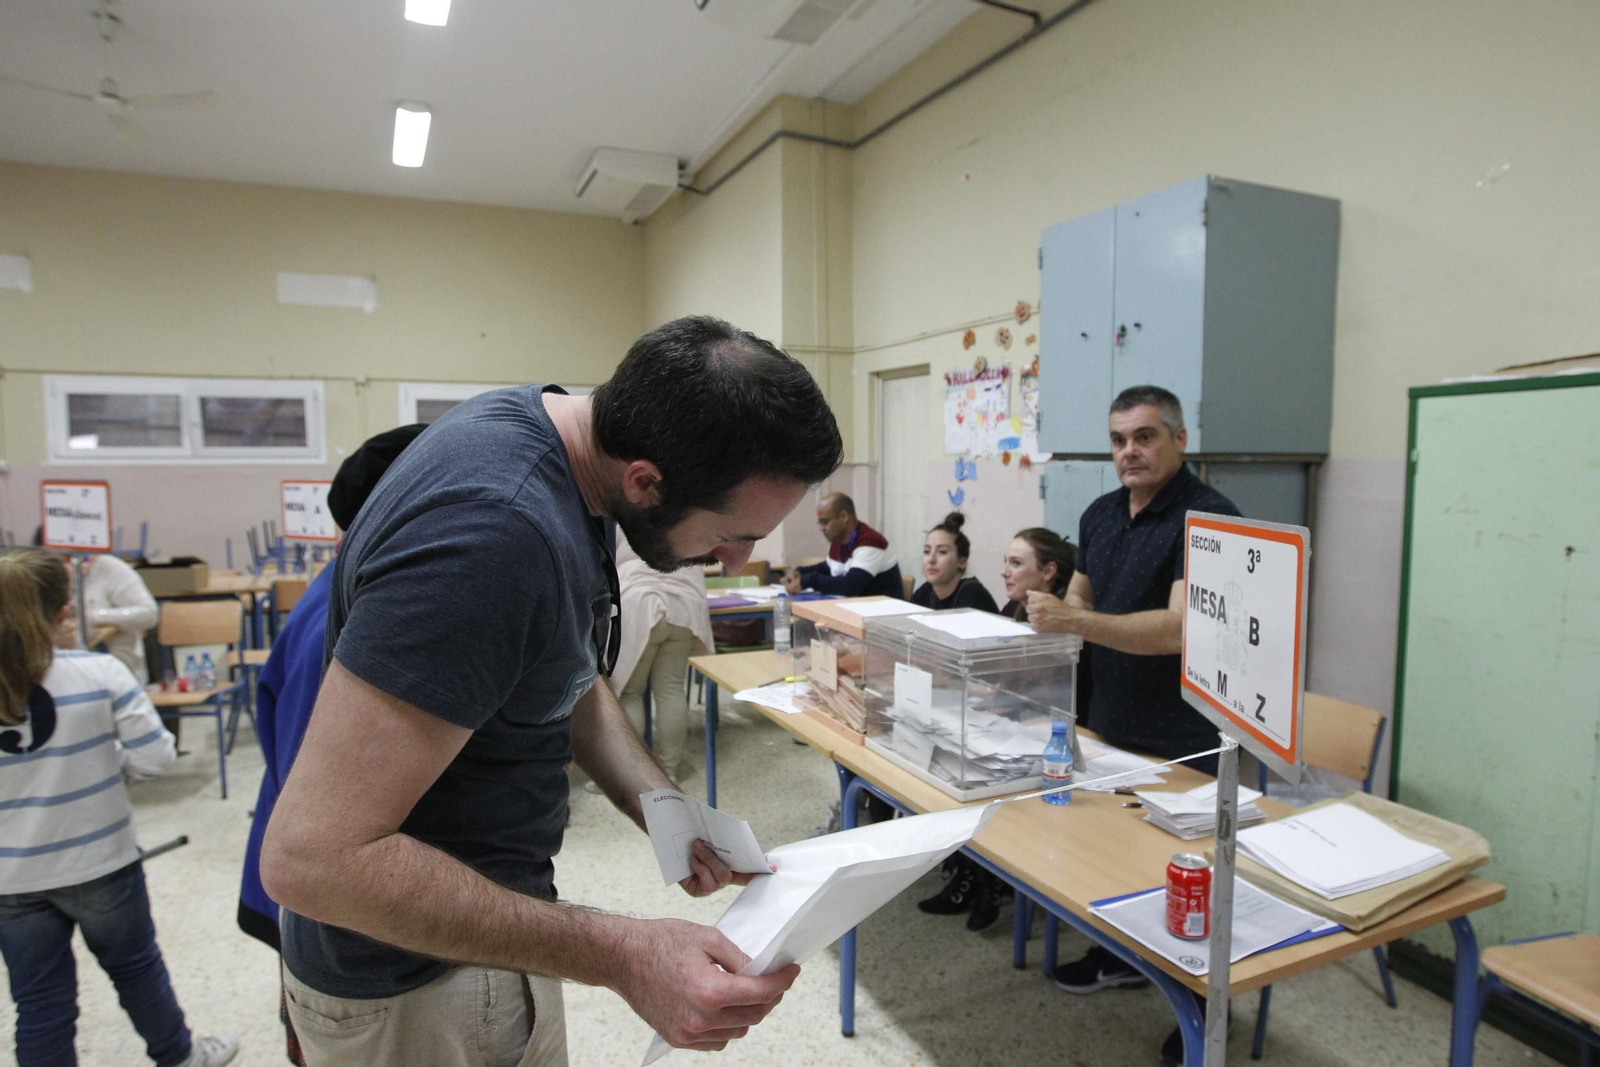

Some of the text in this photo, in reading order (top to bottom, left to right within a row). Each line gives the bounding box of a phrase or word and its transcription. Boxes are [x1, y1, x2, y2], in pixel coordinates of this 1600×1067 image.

[1191, 534, 1221, 555] SECCIÓN
[1190, 583, 1260, 647] MESA B
[1187, 666, 1266, 724] De la letra M a la Z
